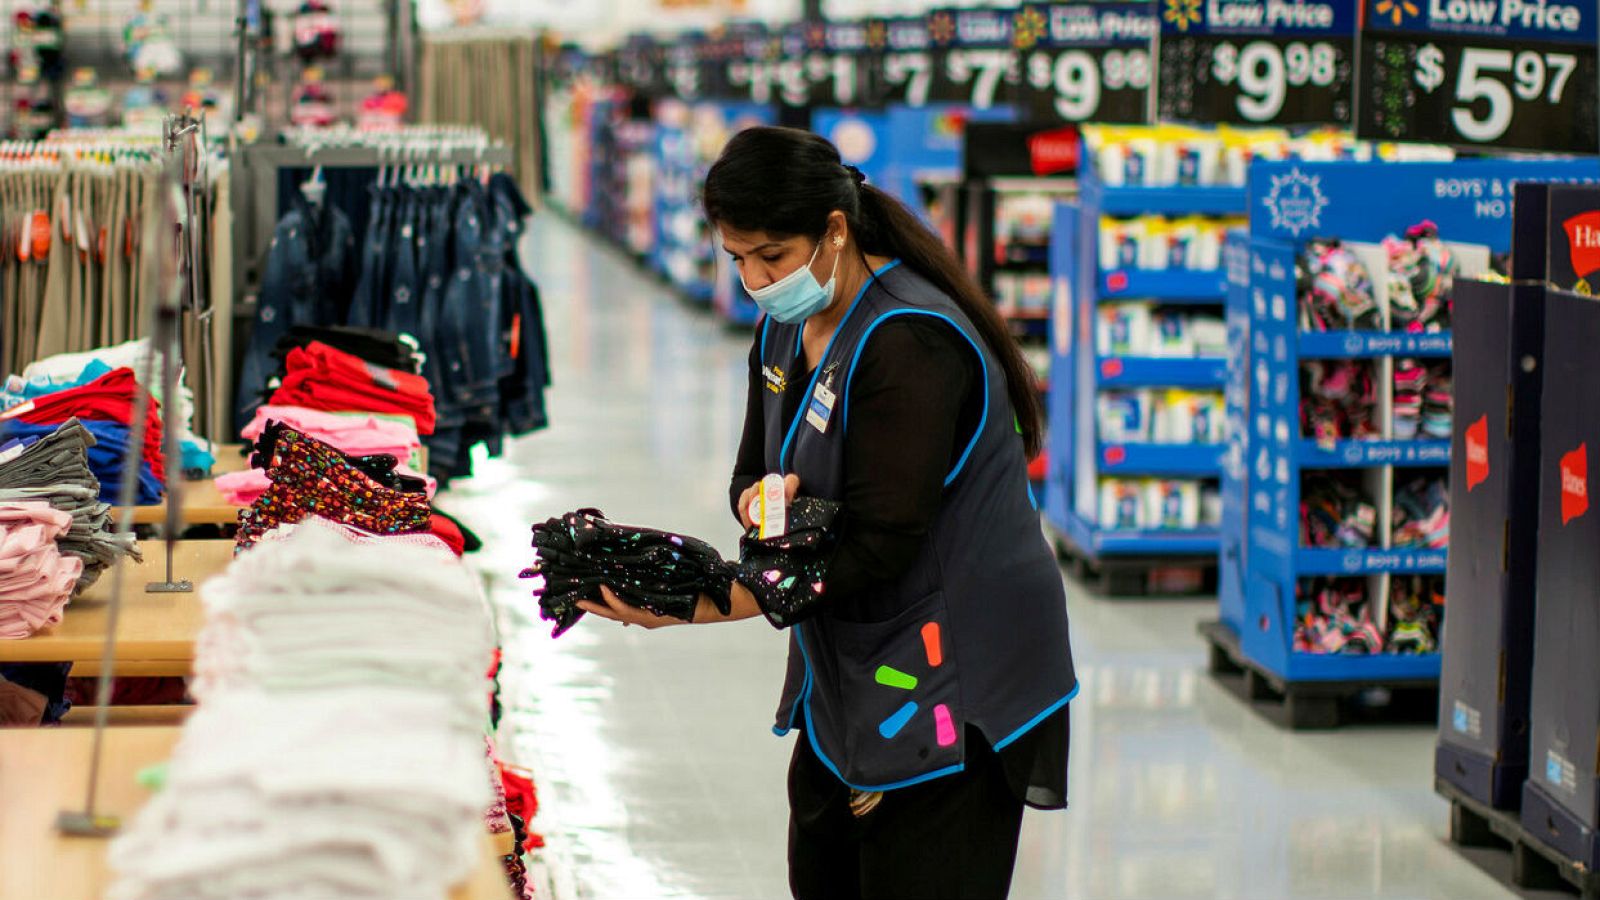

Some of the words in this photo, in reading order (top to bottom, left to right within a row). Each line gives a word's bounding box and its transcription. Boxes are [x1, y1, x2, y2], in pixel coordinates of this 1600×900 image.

[1208, 0, 1264, 27] Low
[1267, 0, 1334, 28] Price
[1429, 0, 1498, 24] Low
[1501, 0, 1582, 31] Price
[1475, 201, 1506, 218] NO
